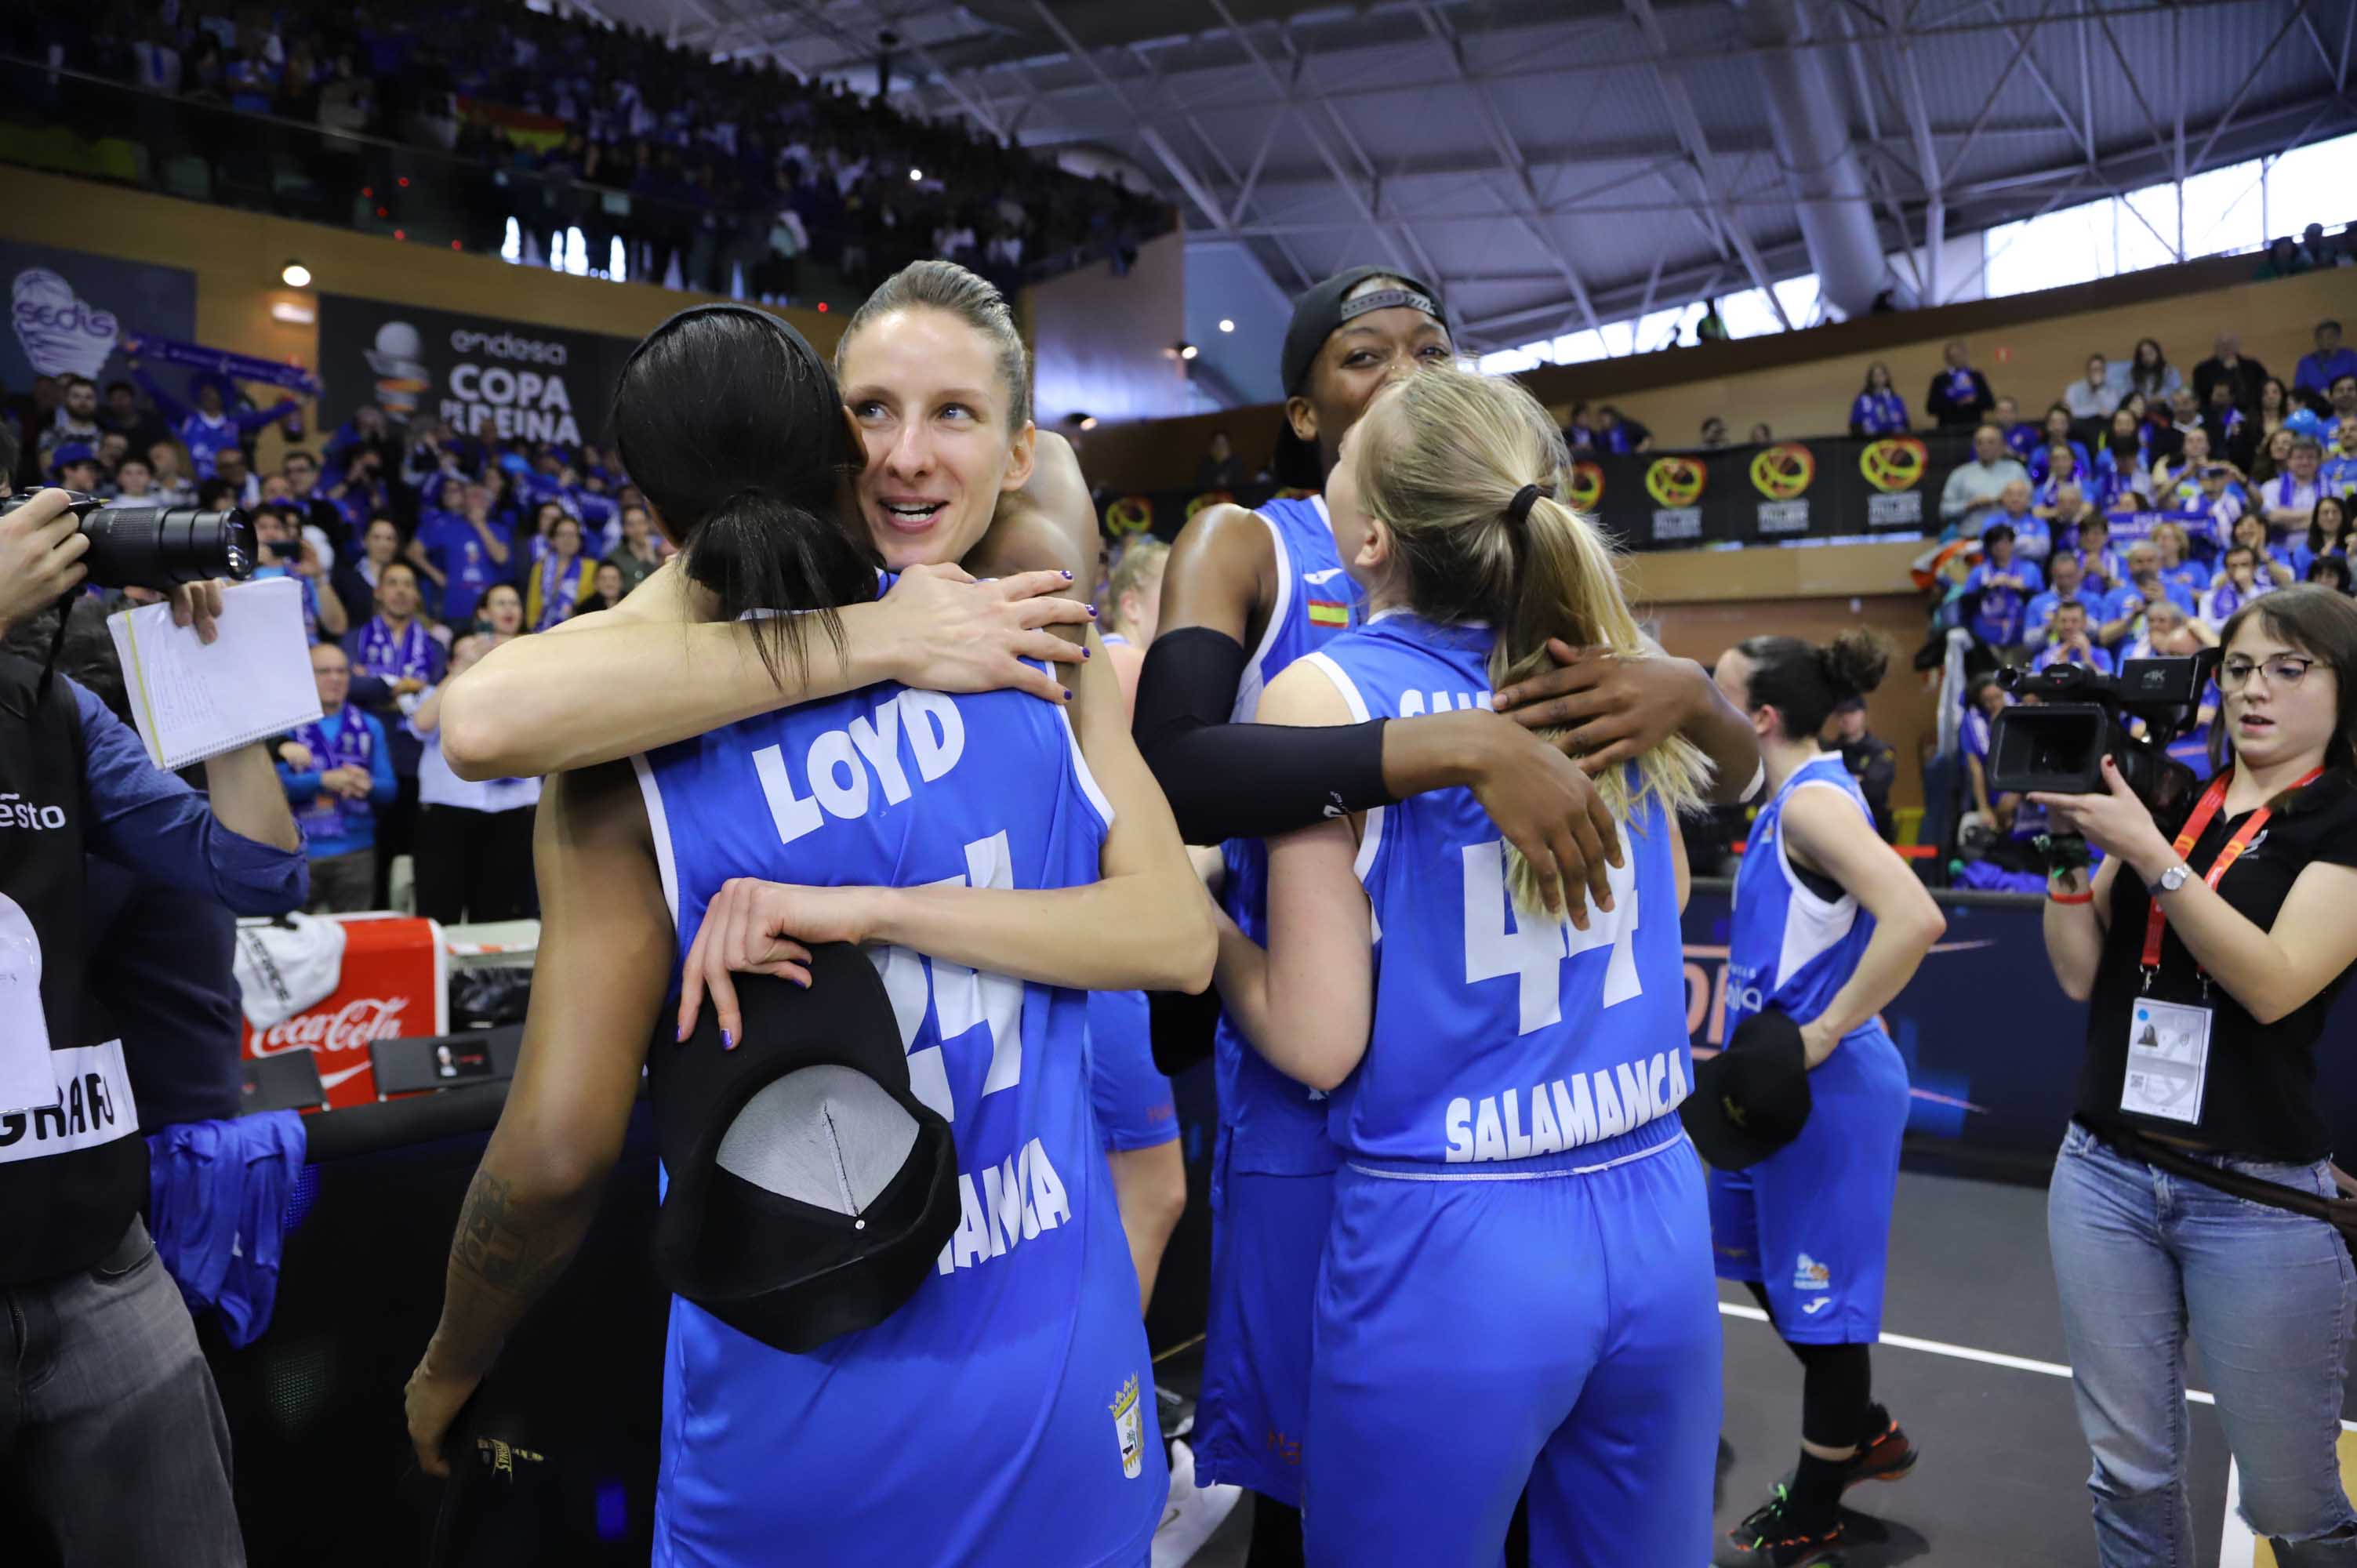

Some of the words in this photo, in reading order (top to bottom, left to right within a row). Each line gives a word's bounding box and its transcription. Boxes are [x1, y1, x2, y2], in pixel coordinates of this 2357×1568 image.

[449, 363, 571, 412] COPA
[450, 329, 567, 365] endesa
[751, 688, 965, 844] LOYD
[1462, 820, 1643, 1036] 44
[1445, 1047, 1687, 1163] SALAMANCA
